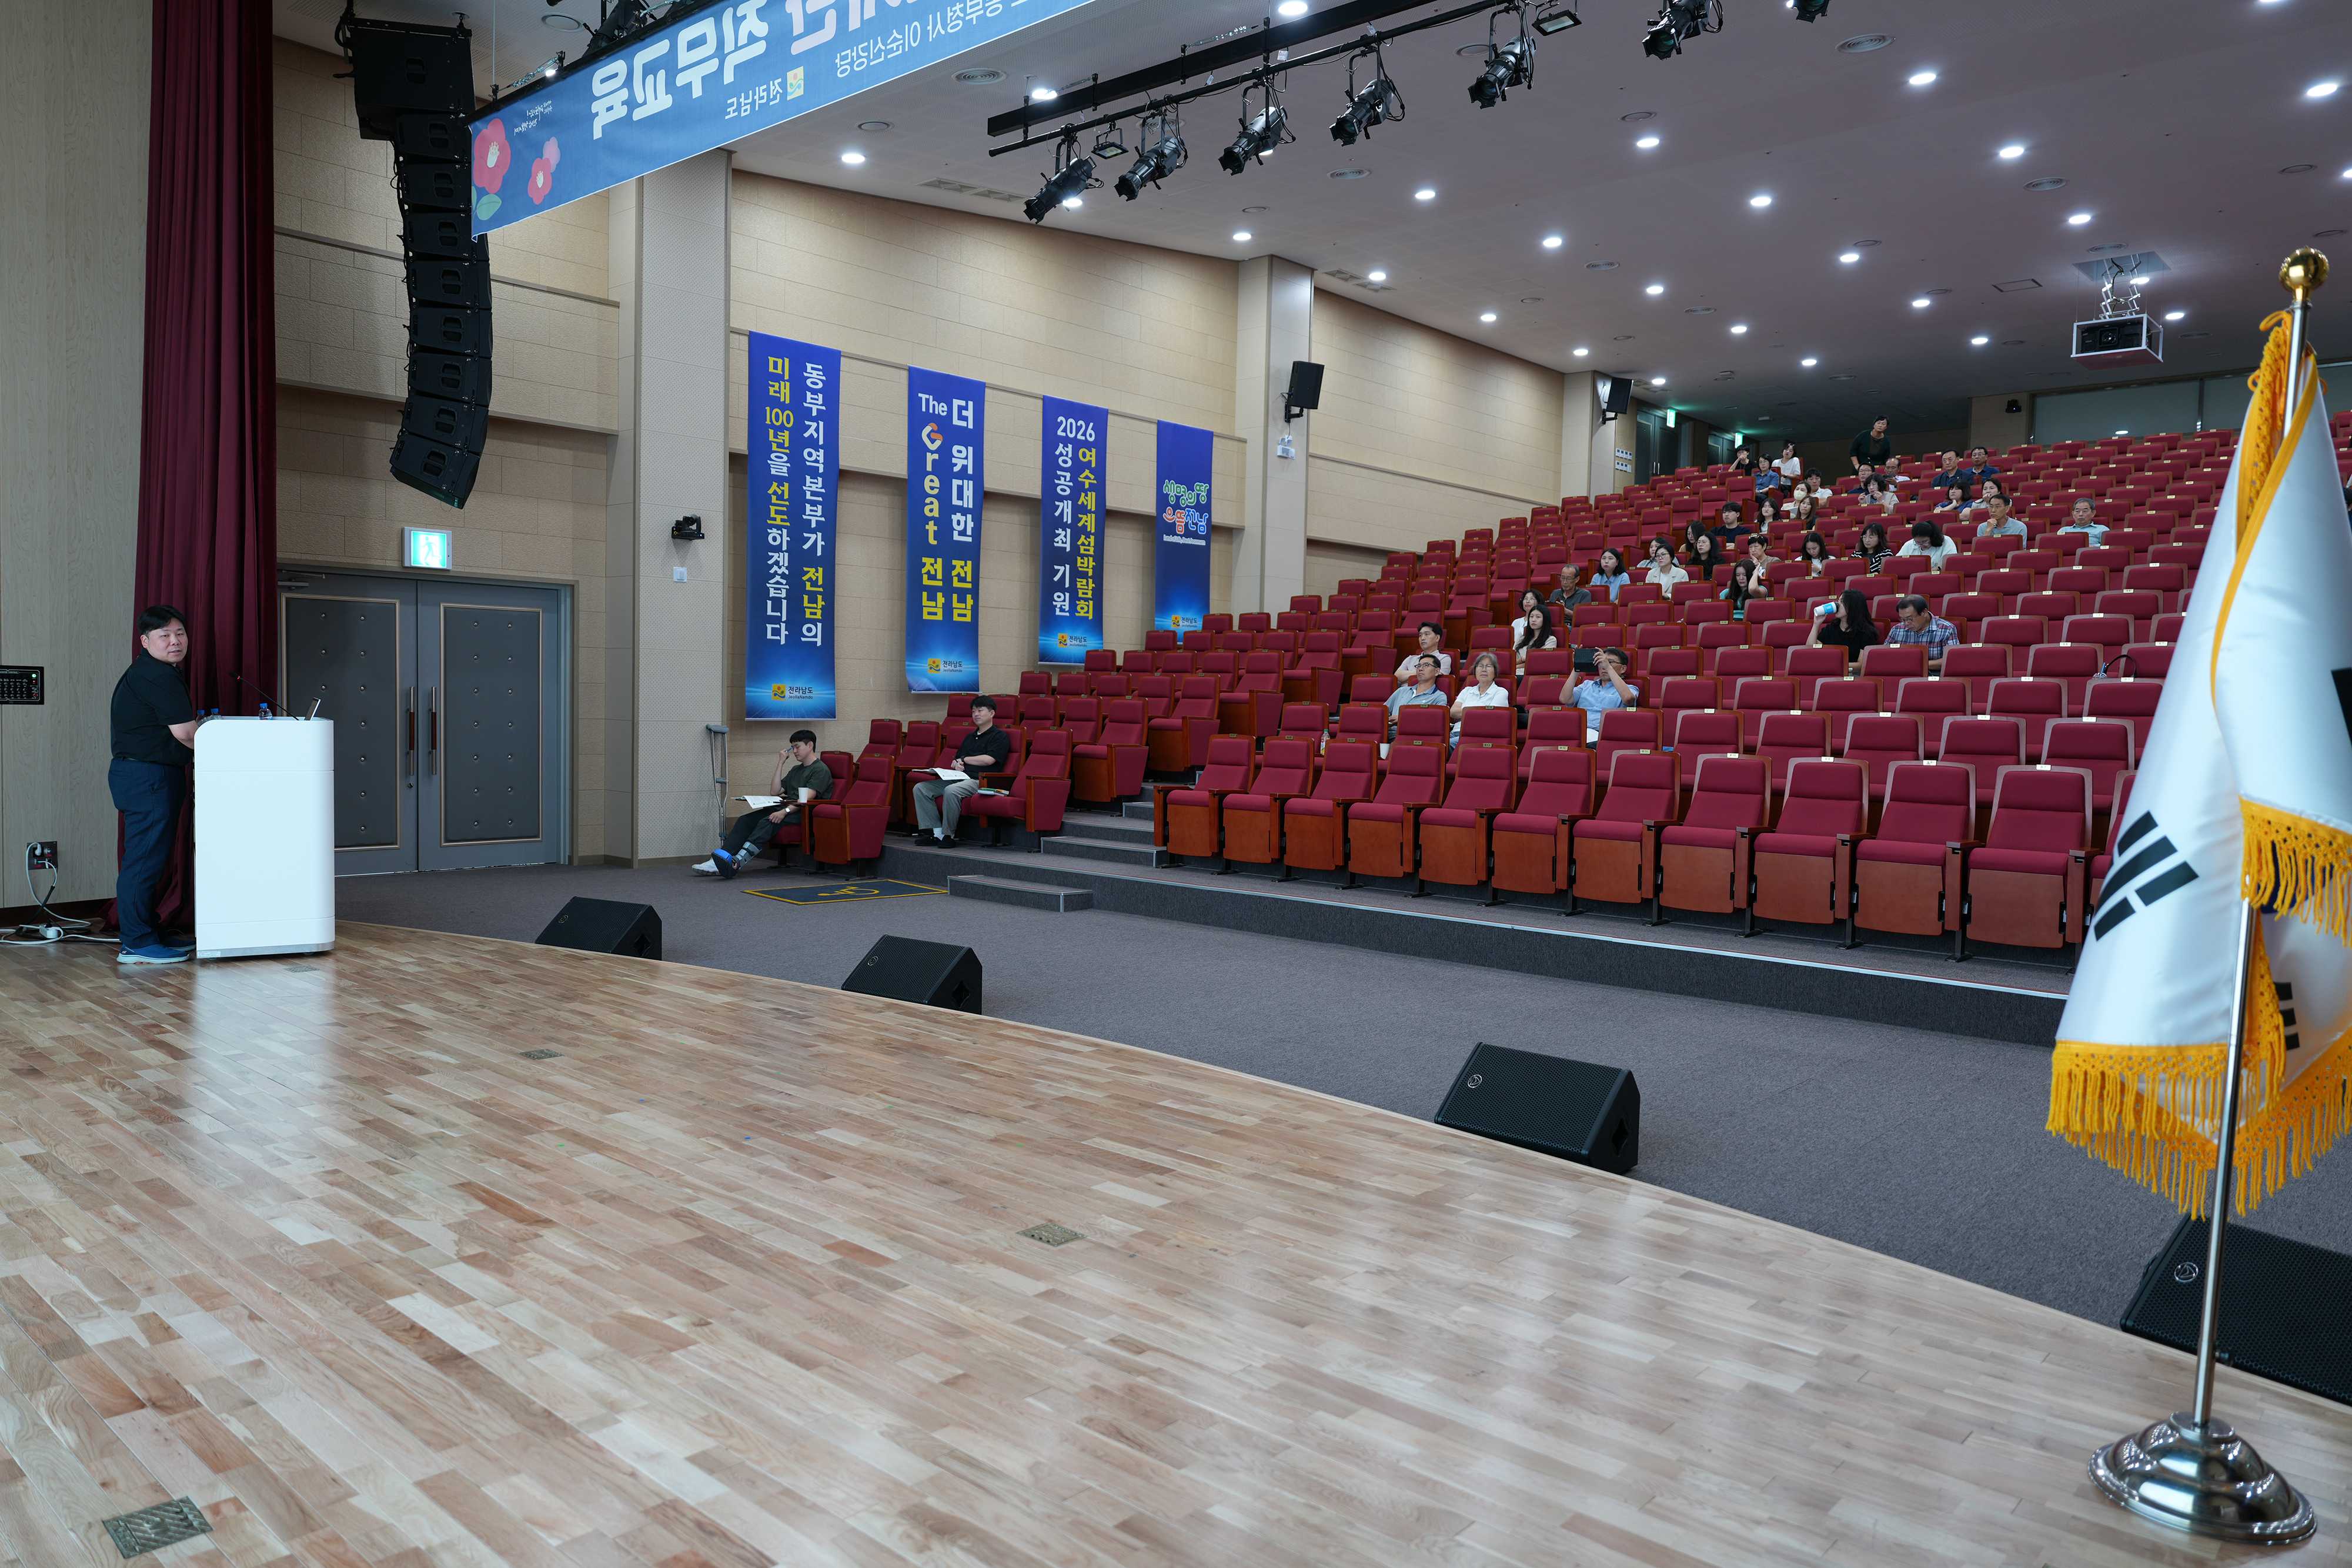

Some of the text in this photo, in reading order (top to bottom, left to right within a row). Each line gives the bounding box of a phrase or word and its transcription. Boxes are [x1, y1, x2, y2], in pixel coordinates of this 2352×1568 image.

[918, 393, 948, 416] The
[1057, 416, 1095, 442] 2026
[765, 356, 794, 645] 미래 100년을 선도하겠습니다
[800, 362, 826, 647] 동부지역본부가 전남의
[951, 398, 974, 622] 더 위대한 전남
[1162, 506, 1208, 534] 으뜸 전남
[1163, 479, 1209, 507] 생명의 땅
[1053, 443, 1073, 616] 성공개최 기원
[1075, 447, 1097, 620] 여수세계섬박람회
[921, 557, 945, 620] 전남
[788, 686, 813, 694] 전라남도
